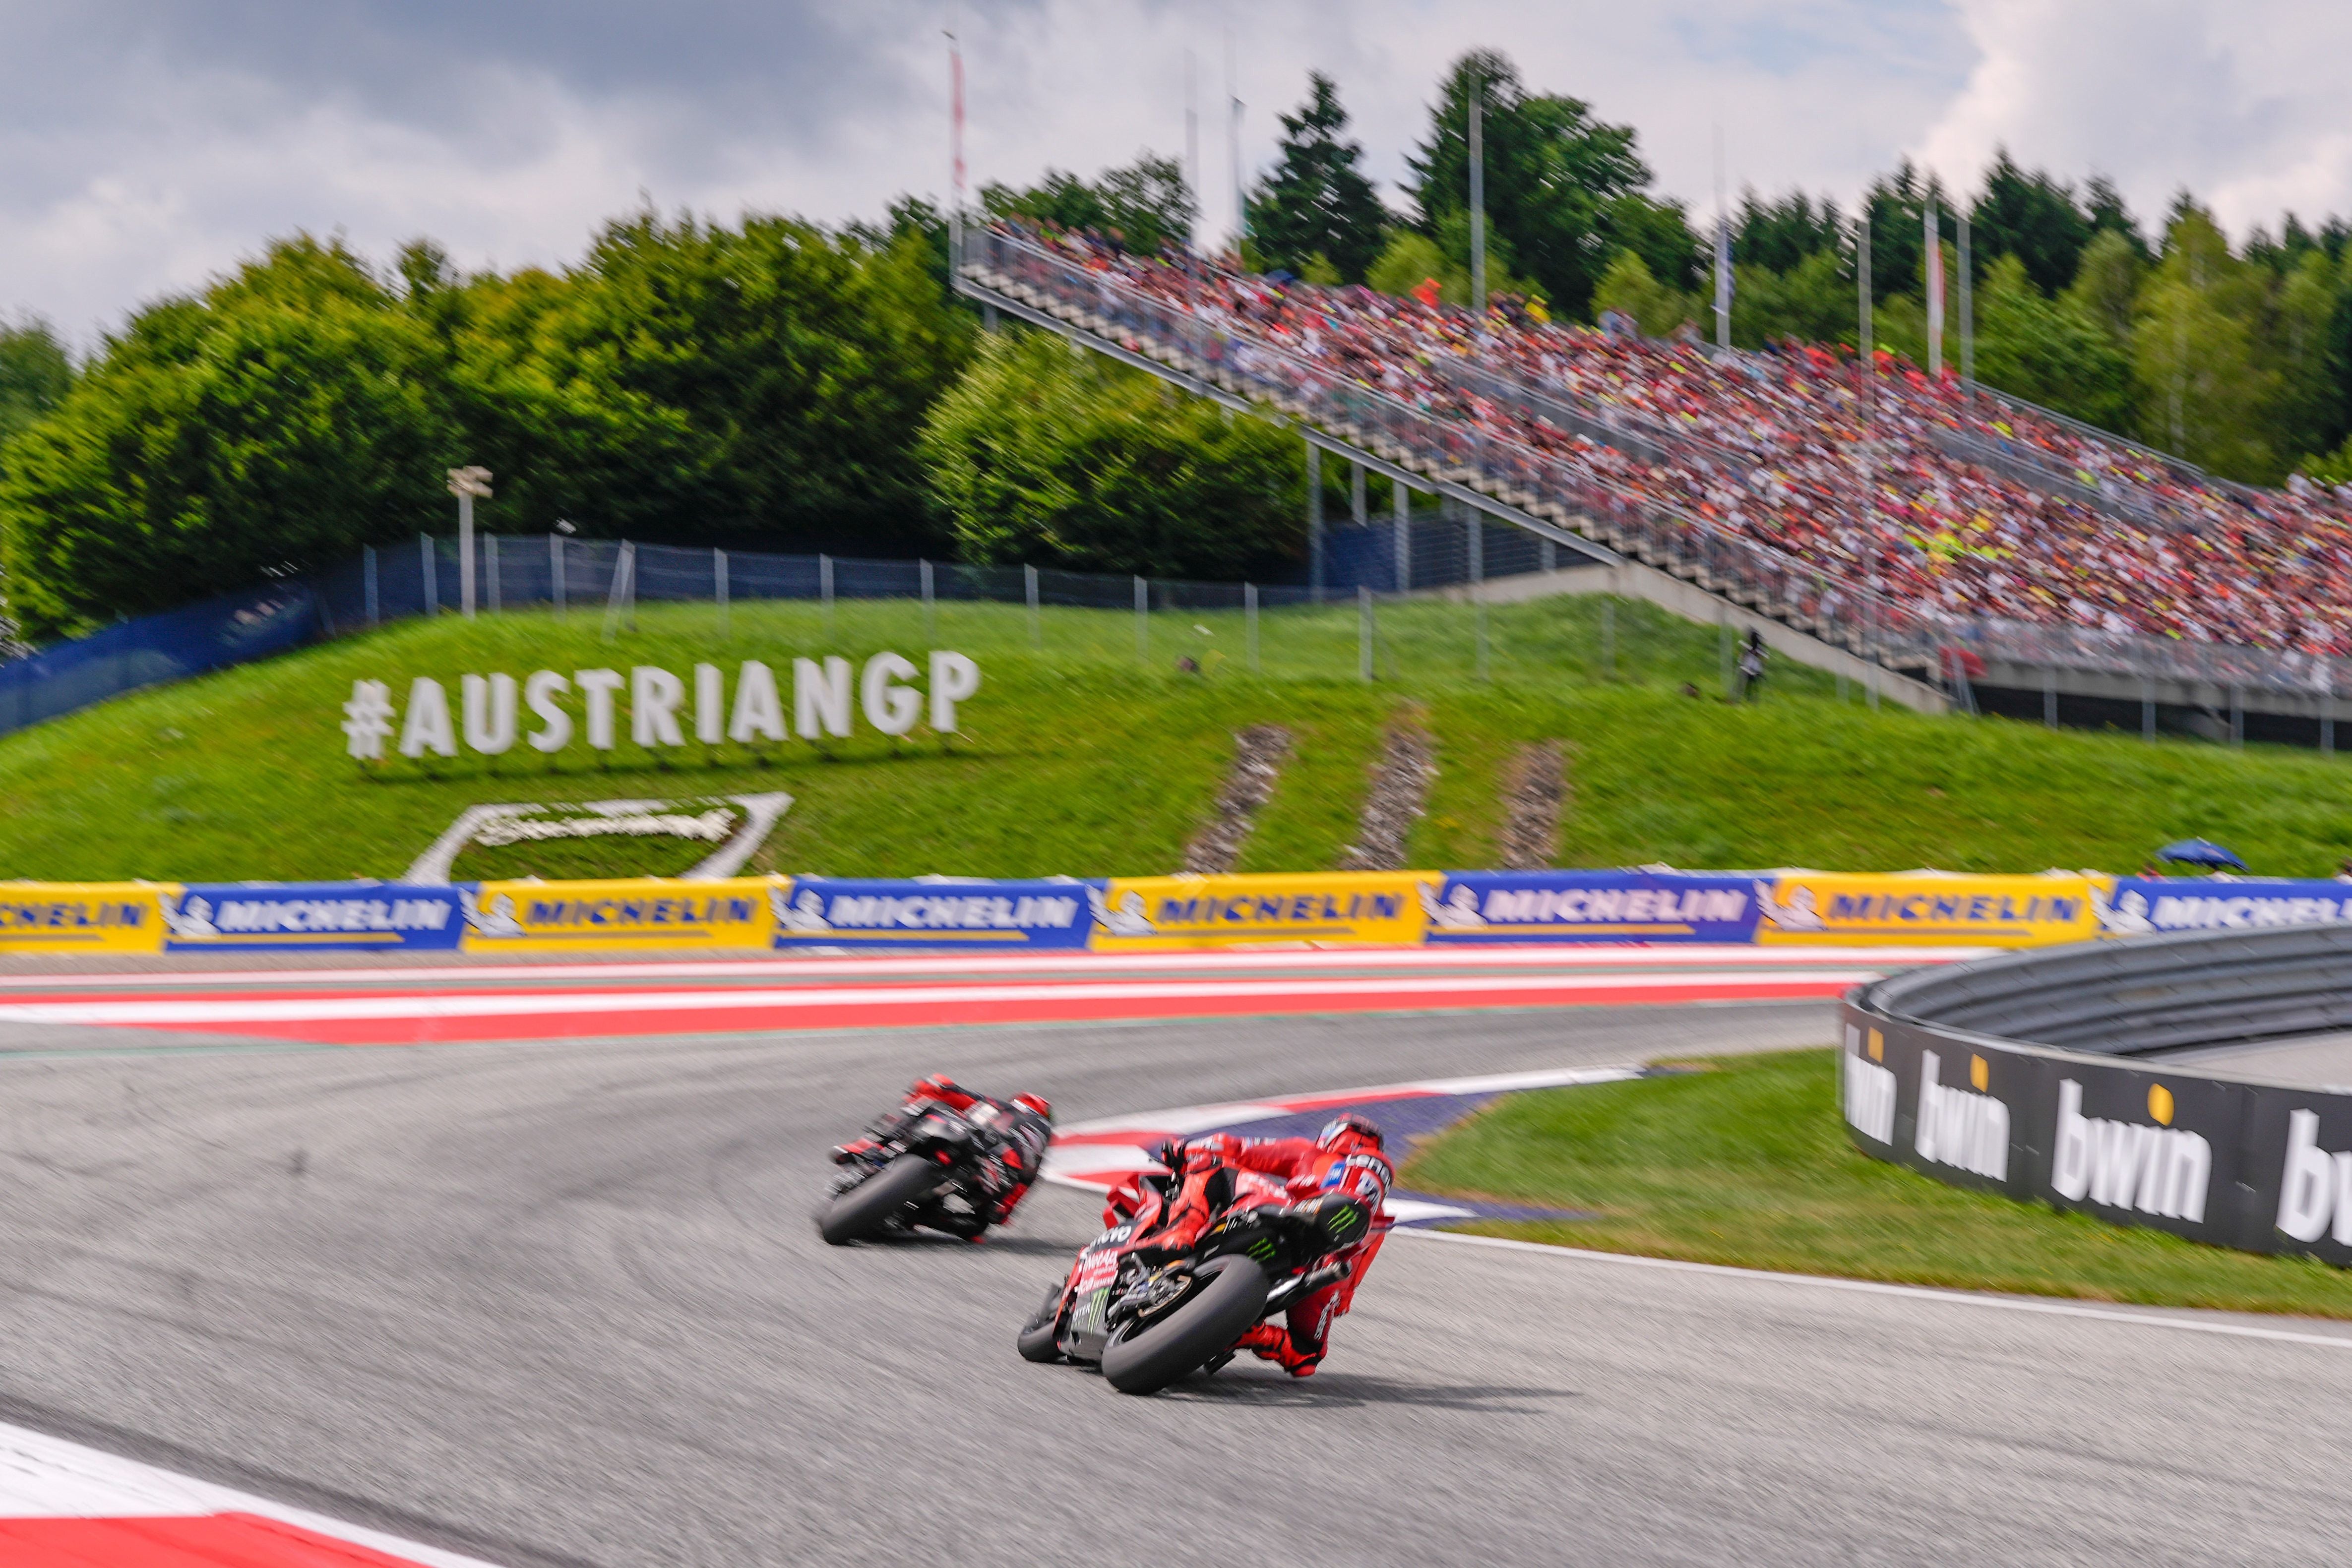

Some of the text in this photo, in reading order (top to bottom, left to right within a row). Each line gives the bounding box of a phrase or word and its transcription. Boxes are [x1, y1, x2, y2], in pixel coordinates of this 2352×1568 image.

[341, 650, 981, 759] #AUSTRIANGP
[215, 899, 452, 931] MICHELIN
[525, 898, 758, 926] MICHELIN
[826, 896, 1079, 928] MICHELIN
[1155, 894, 1409, 923] MICHELIN
[1482, 889, 1749, 922] MICHELIN
[1826, 893, 2083, 924] MICHELIN
[1915, 1048, 2011, 1183] bwin
[2051, 1078, 2212, 1224] bwin
